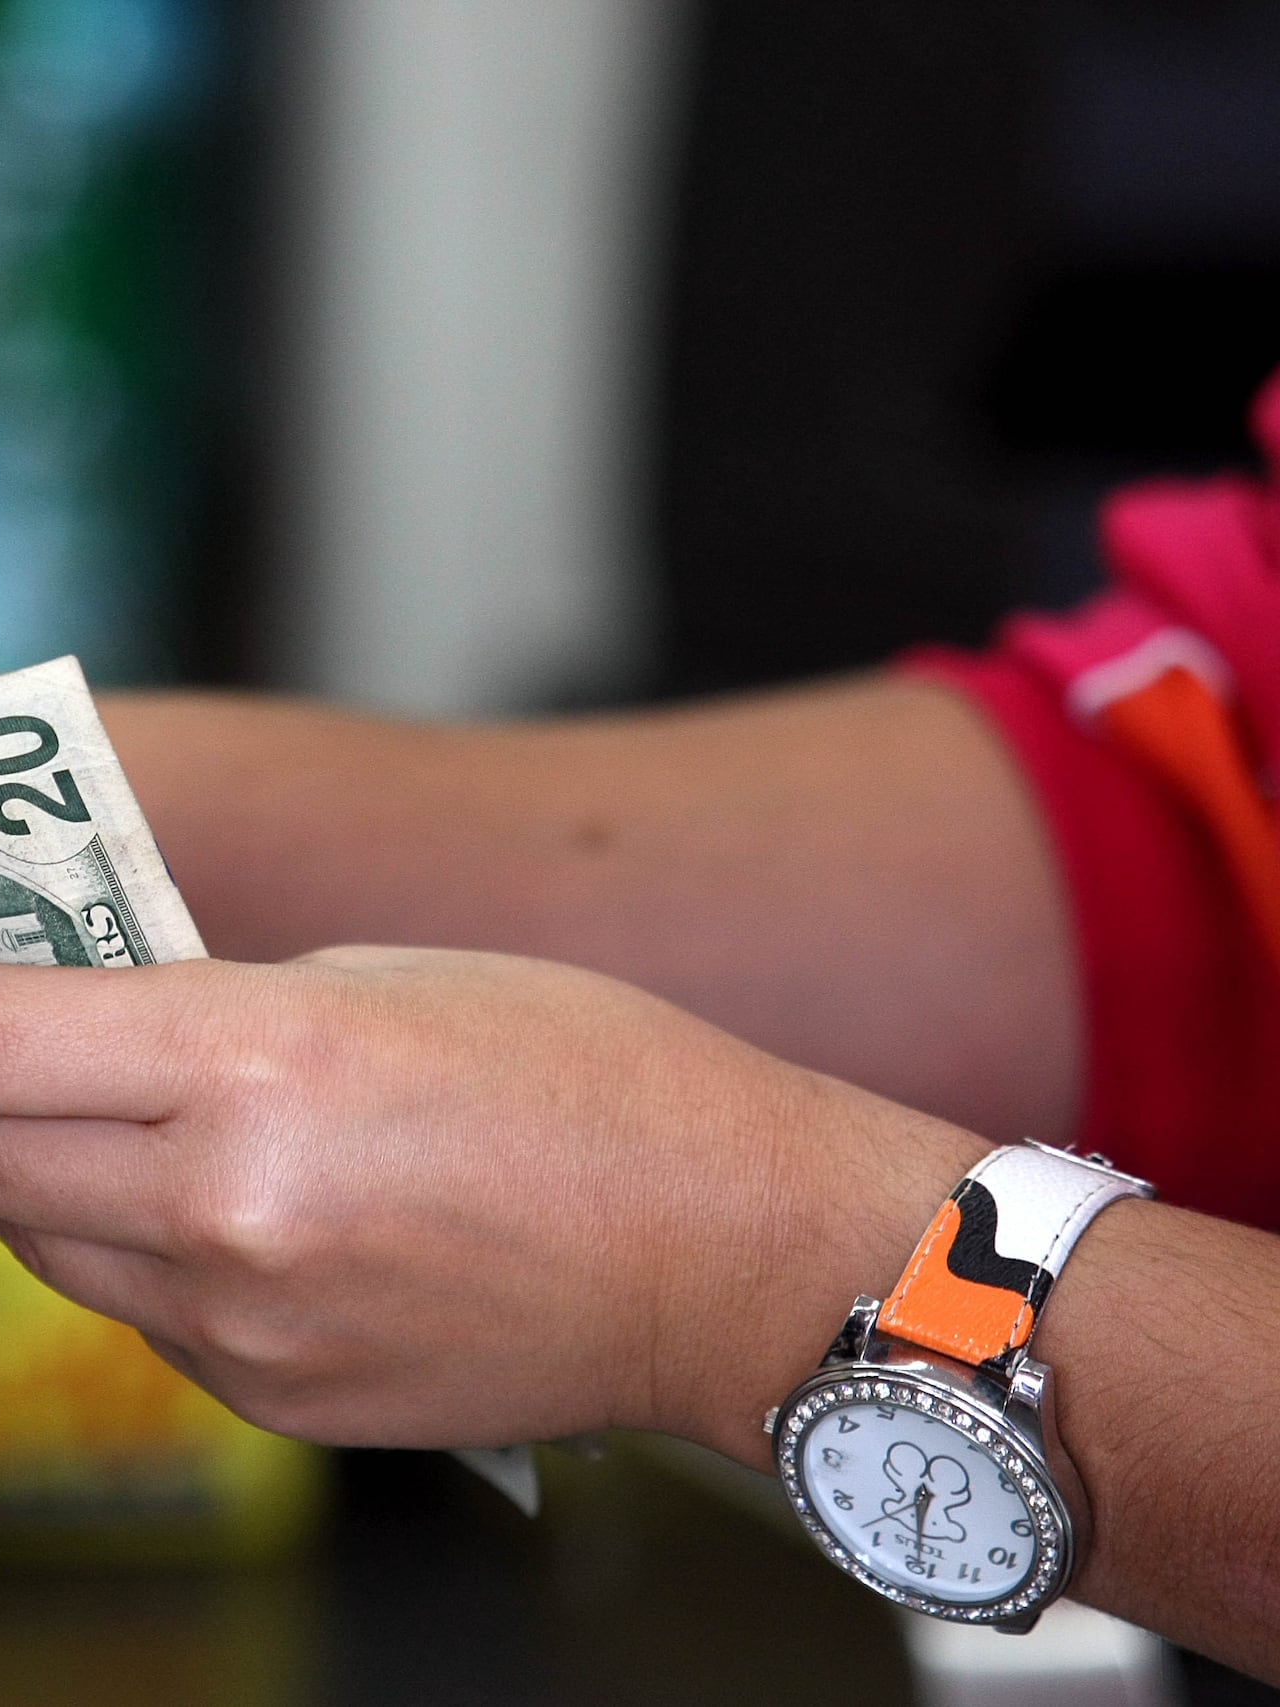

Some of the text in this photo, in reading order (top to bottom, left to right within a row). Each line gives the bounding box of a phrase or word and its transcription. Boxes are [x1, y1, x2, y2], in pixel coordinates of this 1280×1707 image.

[66, 867, 79, 880] 27
[80, 903, 136, 968] RS
[838, 1415, 860, 1434] 4
[832, 1489, 855, 1511] 2
[1009, 1518, 1033, 1538] 9
[871, 1531, 881, 1548] 1
[904, 1554, 938, 1580] 12
[987, 1546, 1018, 1570] 10
[957, 1563, 982, 1584] 11
